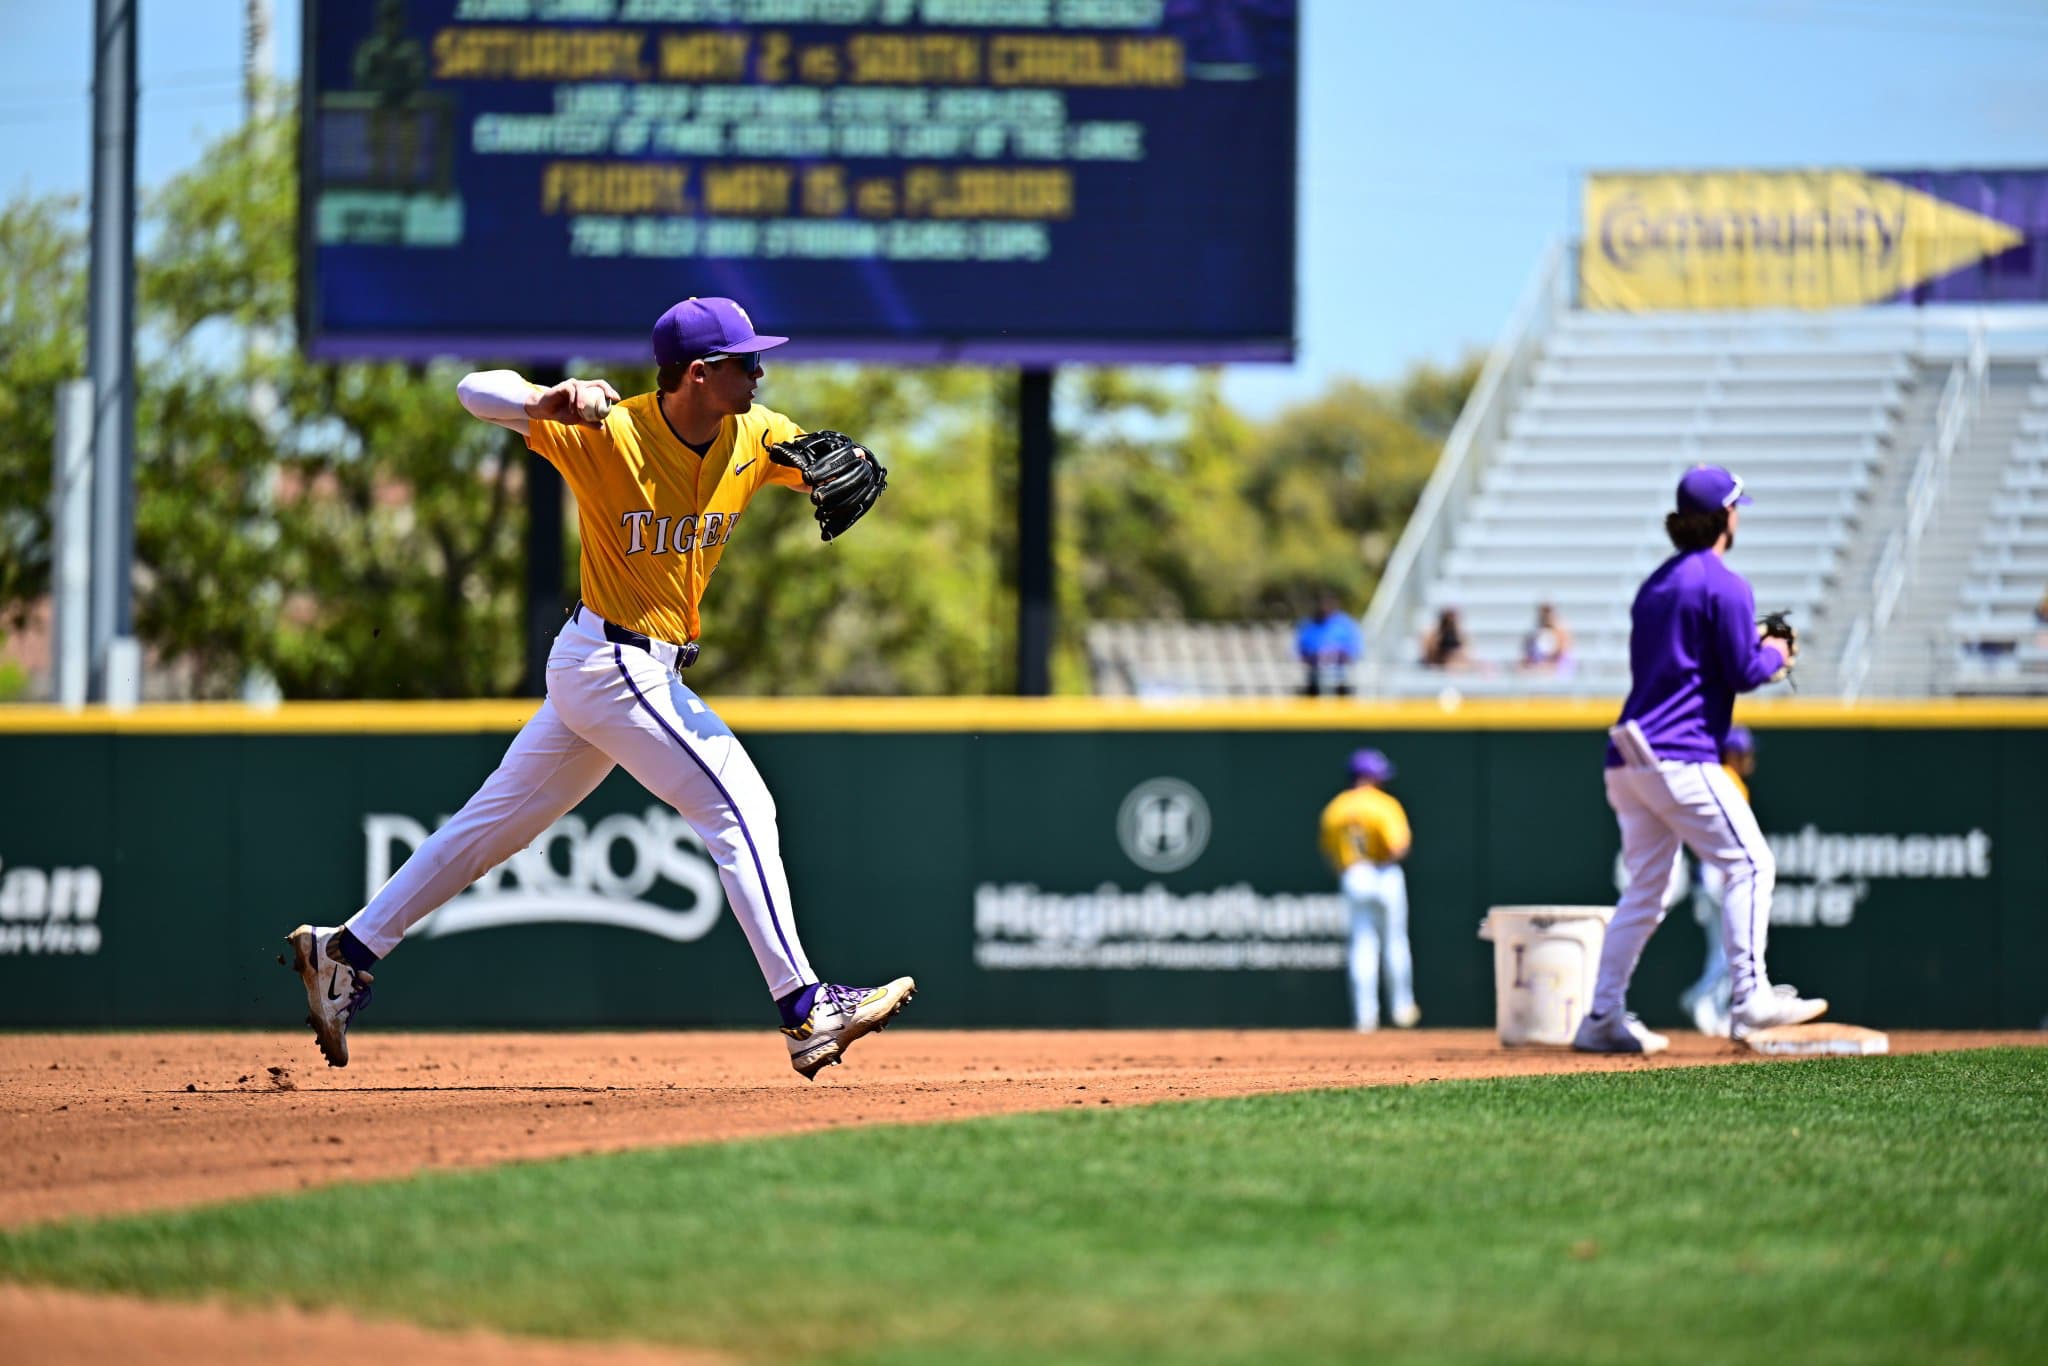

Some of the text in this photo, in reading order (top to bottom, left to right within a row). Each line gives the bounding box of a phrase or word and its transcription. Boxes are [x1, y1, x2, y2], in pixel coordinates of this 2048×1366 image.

[433, 28, 648, 80] SATURDAY,
[658, 31, 748, 80] MAY
[756, 31, 792, 82] 2
[847, 34, 980, 84] SOUTH
[985, 36, 1184, 87] CAROLINA
[542, 162, 697, 215] FRIDAY,
[703, 163, 793, 214] MAY
[903, 166, 1073, 221] FLORIDA
[1600, 192, 1905, 272] Community
[1763, 823, 1993, 881] uipment
[0, 862, 103, 921] an
[973, 882, 1346, 946] Higginbotham
